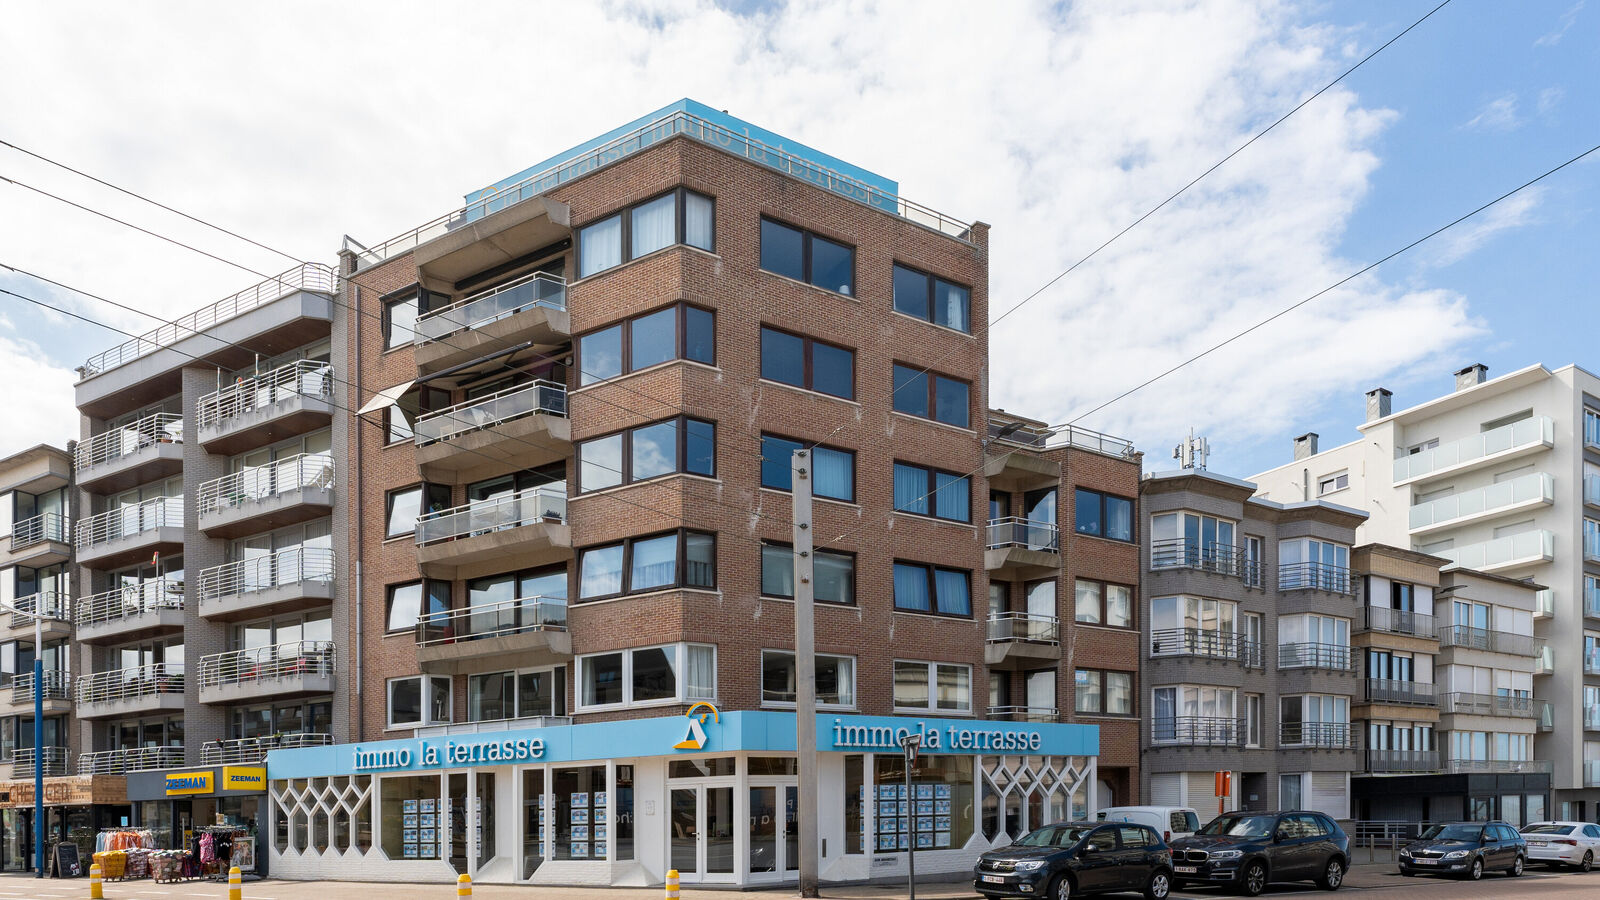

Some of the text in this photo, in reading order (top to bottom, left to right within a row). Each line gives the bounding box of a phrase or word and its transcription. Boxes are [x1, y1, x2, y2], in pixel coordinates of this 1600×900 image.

[833, 718, 1042, 750] immo la terrasse
[353, 737, 545, 770] immo la terrasse
[166, 776, 206, 790] ZEEMAN
